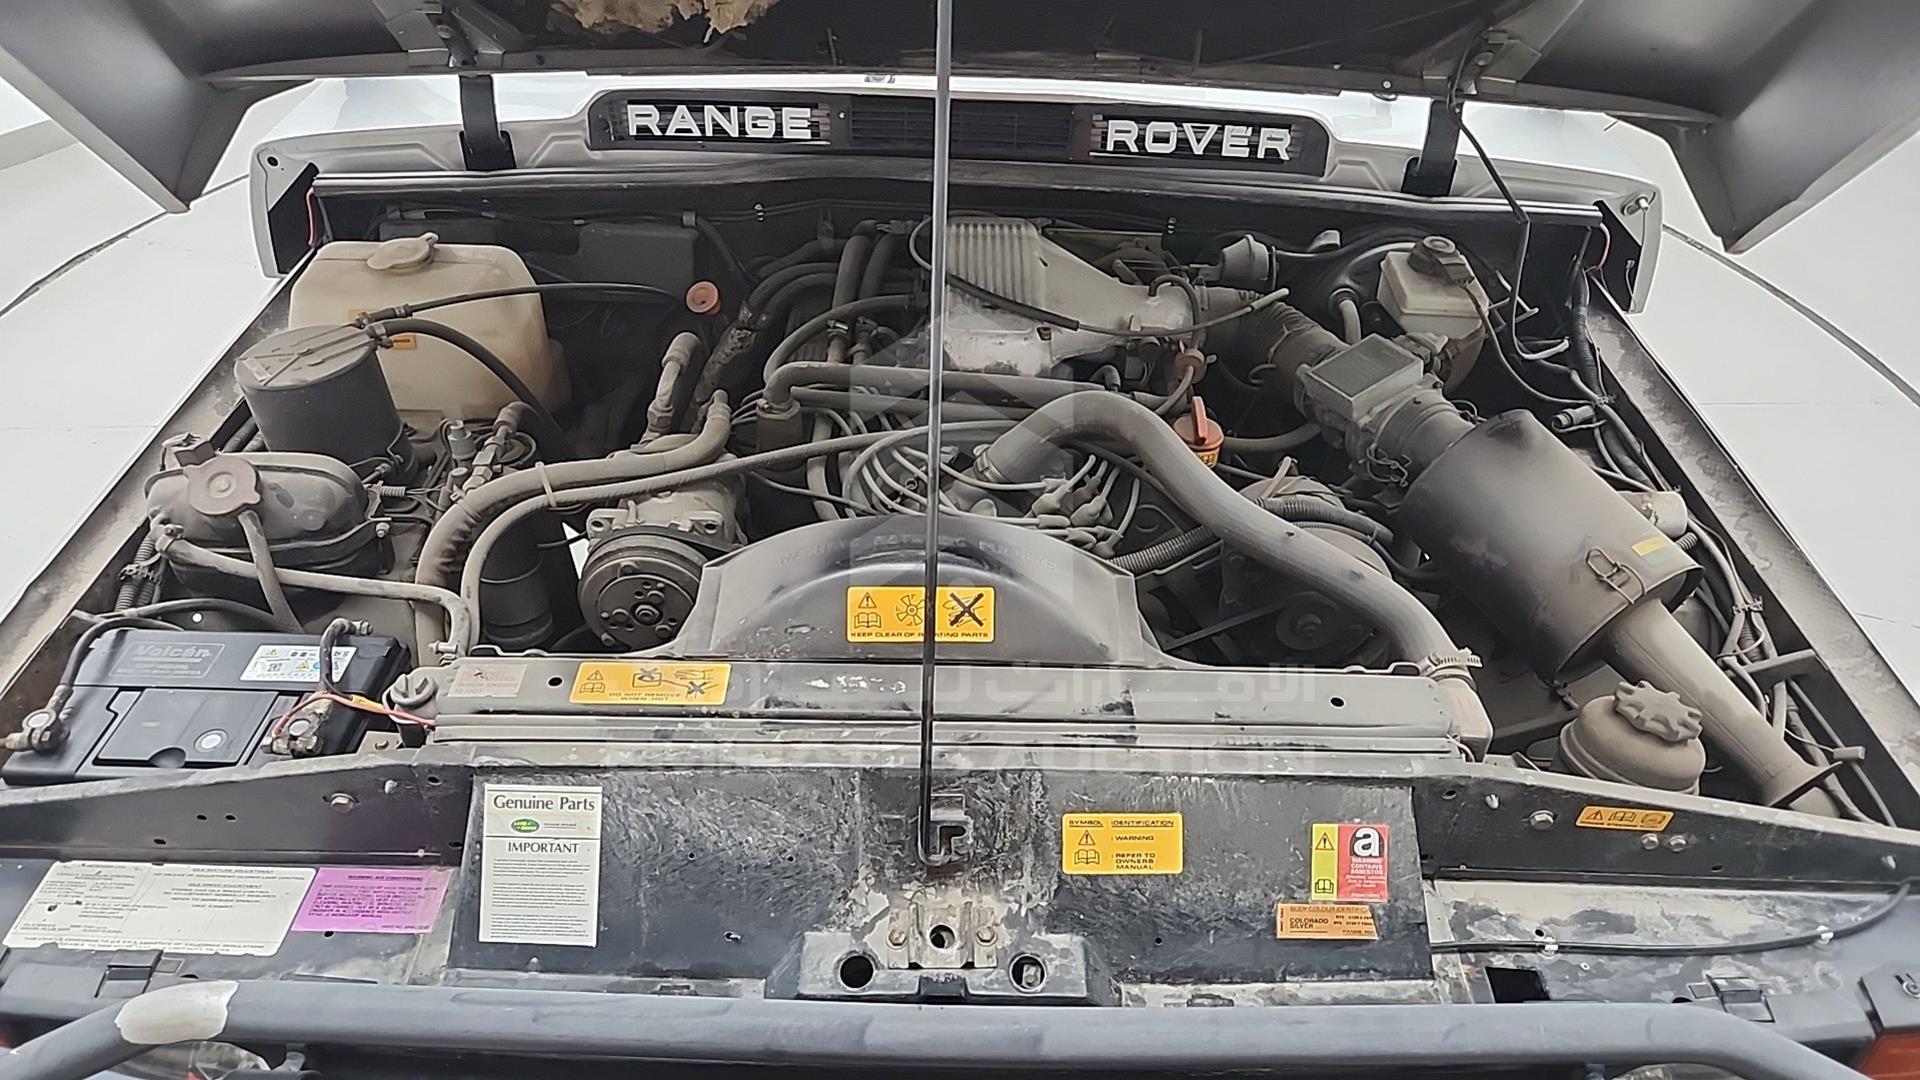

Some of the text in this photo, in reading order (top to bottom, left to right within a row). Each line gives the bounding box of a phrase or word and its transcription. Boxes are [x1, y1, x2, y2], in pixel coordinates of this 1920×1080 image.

[626, 104, 1291, 161] RANGE ROVER
[493, 794, 595, 811] Genuine Parts
[508, 841, 579, 853] IMPORTANT
[1353, 827, 1380, 857] a
